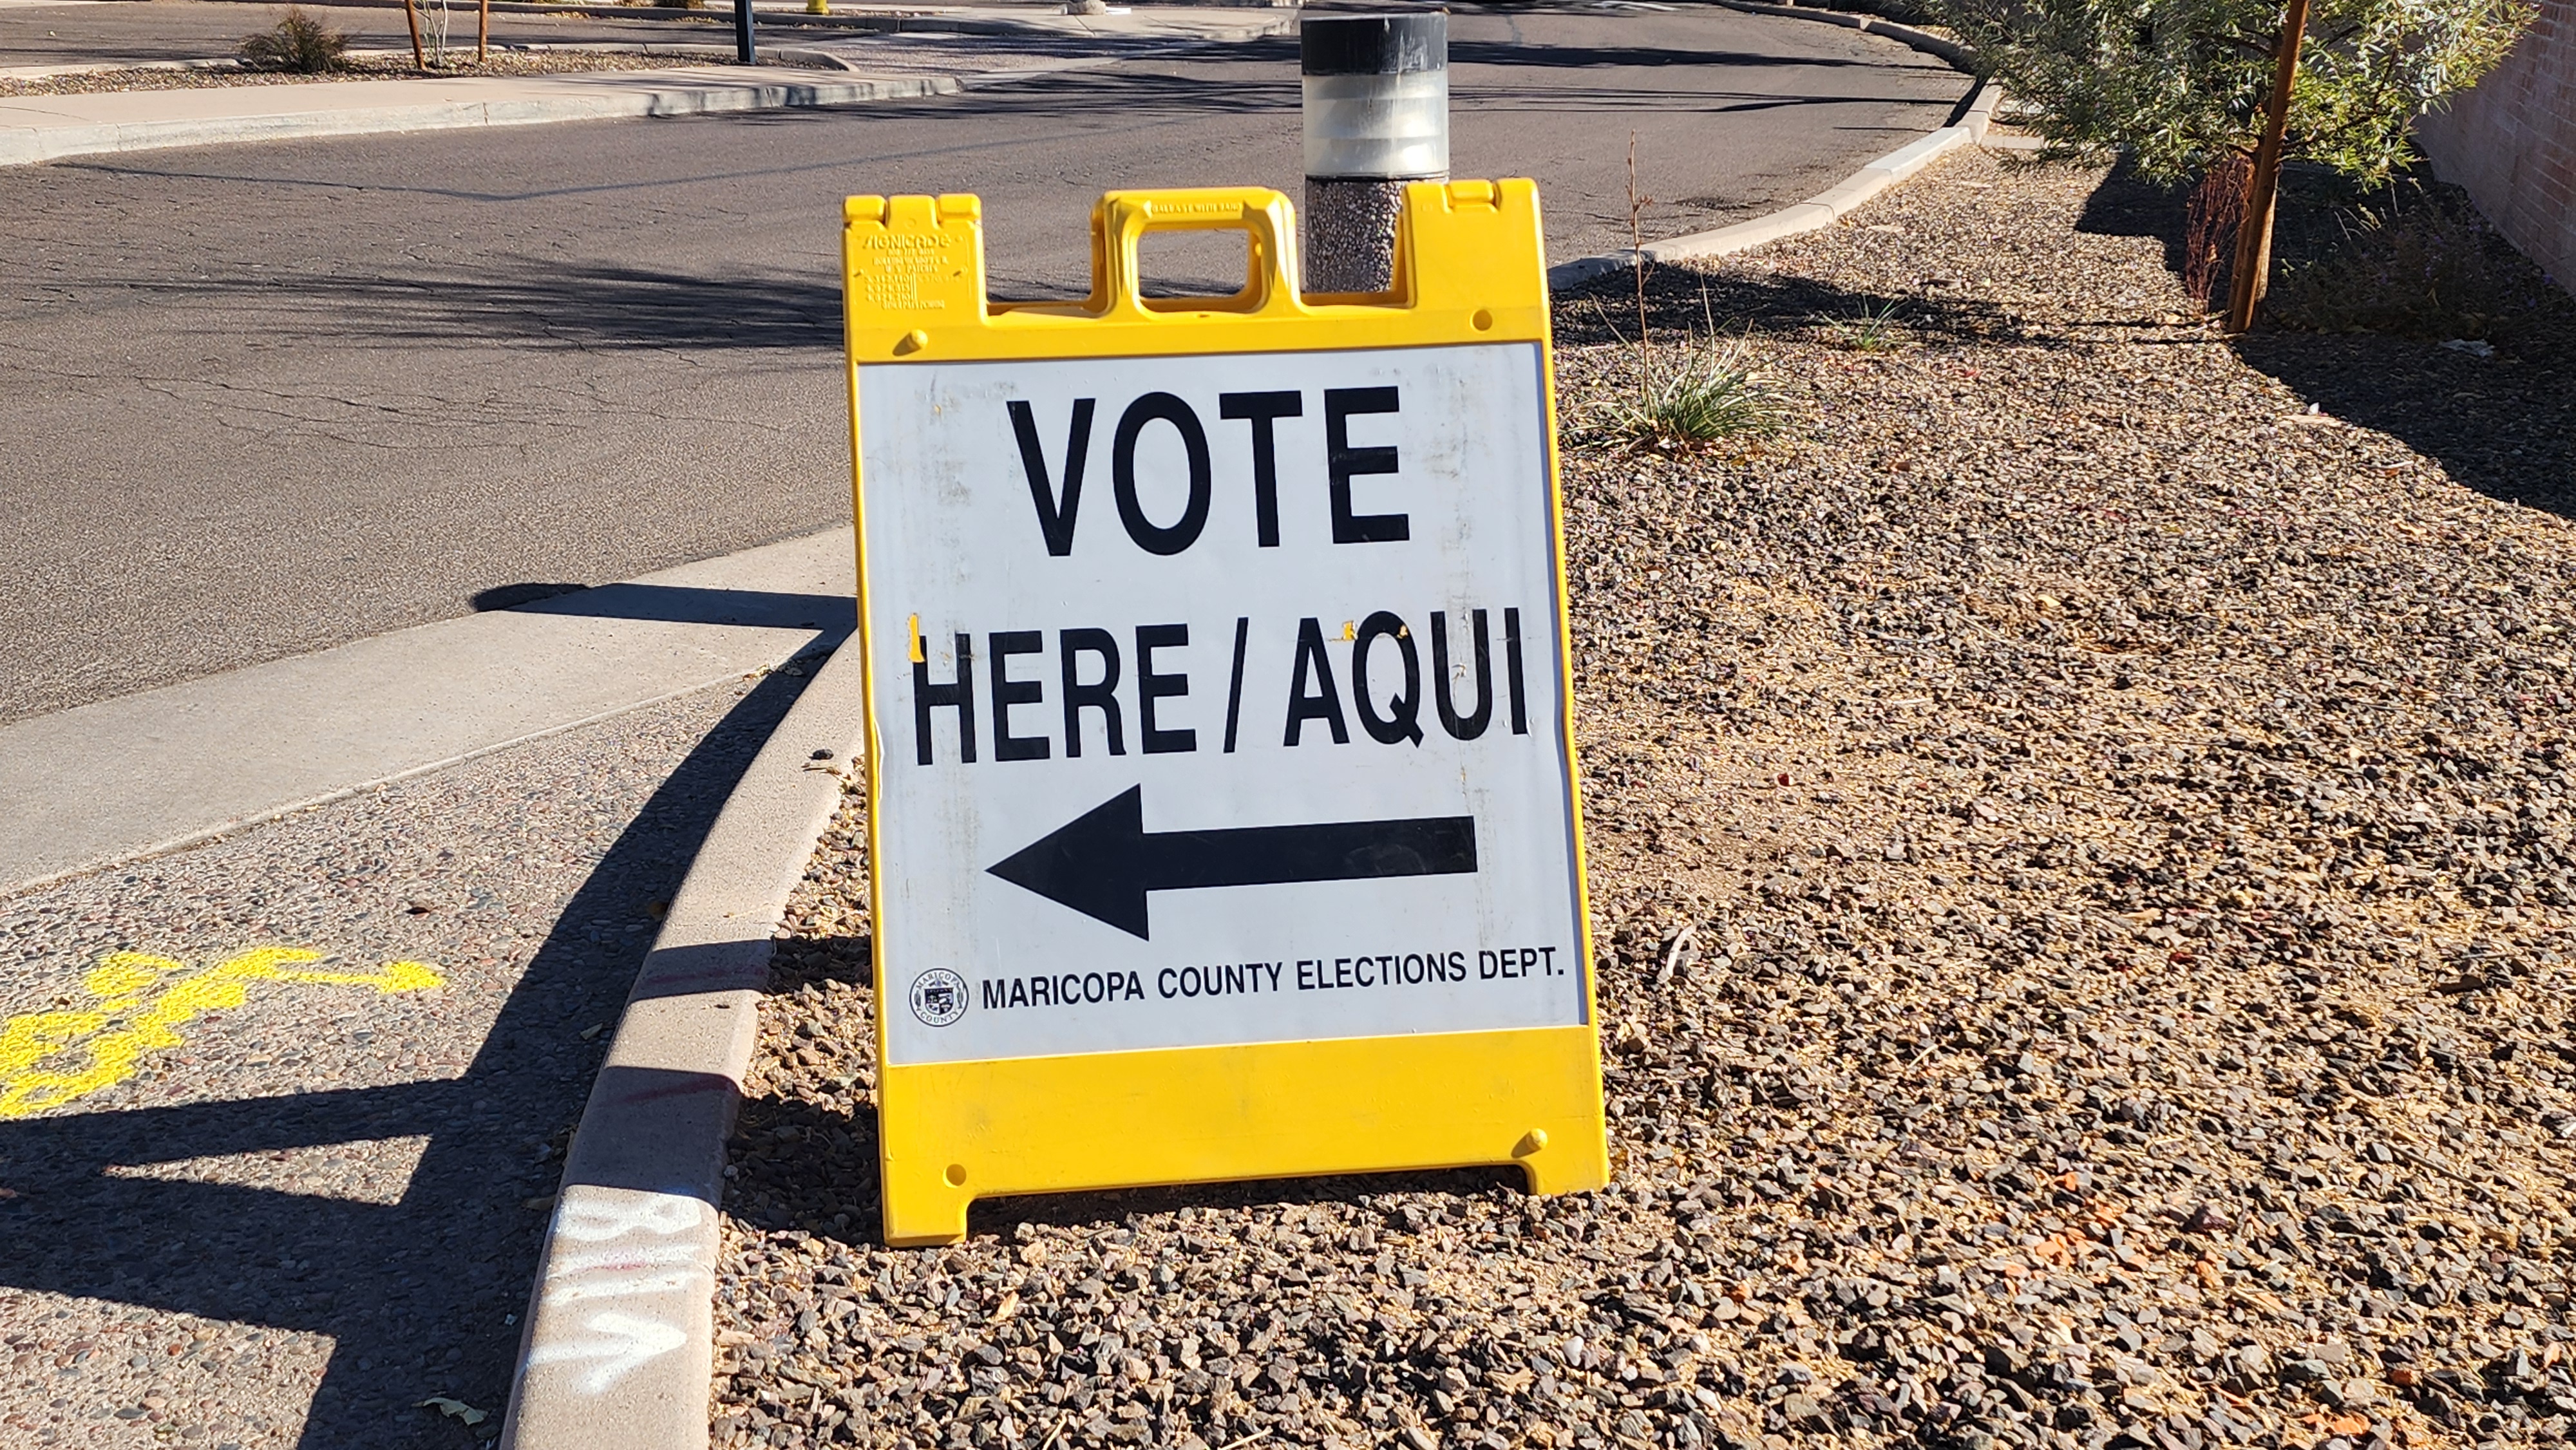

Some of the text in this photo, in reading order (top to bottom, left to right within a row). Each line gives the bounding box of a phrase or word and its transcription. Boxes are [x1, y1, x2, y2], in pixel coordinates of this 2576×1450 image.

[1007, 386, 1410, 556] VOTE
[912, 624, 1197, 766] HERE
[1283, 608, 1528, 748] AQUI
[983, 946, 1564, 1009] MARICOPA COUNTY ELECTIONS DEPT.
